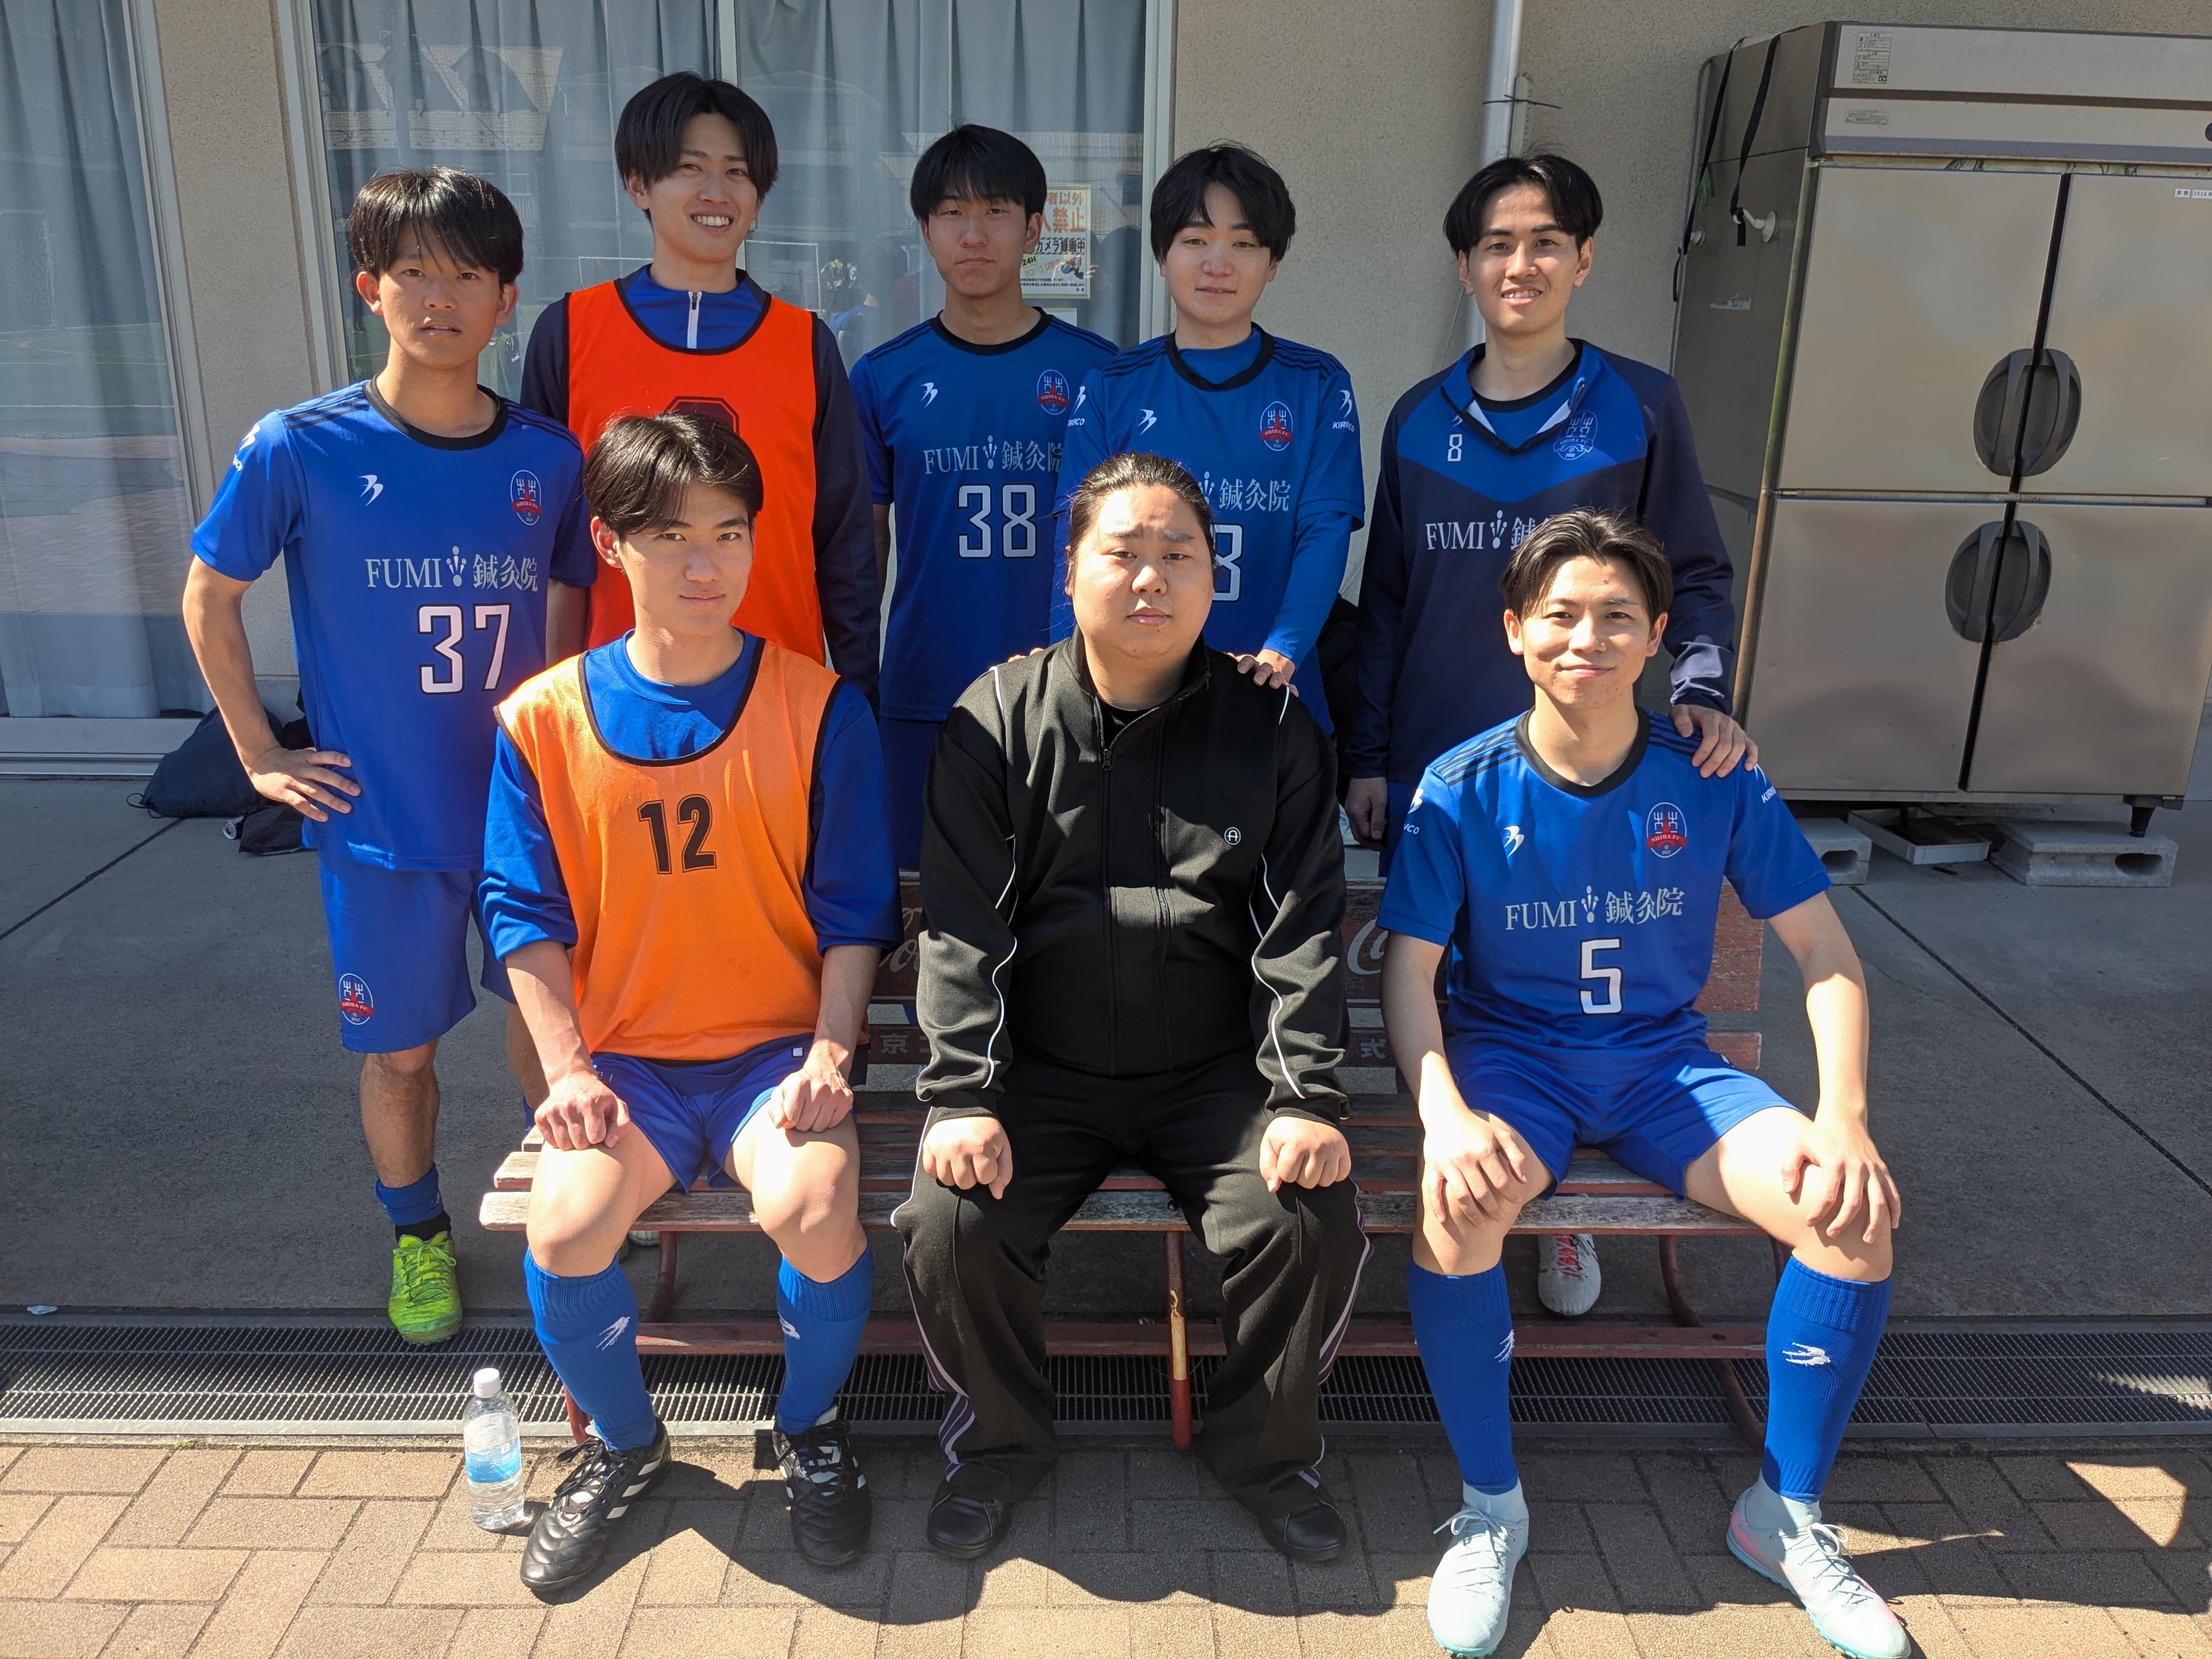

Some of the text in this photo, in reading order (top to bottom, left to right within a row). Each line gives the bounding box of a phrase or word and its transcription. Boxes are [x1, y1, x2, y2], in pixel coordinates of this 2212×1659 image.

[1023, 256, 1036, 266] 24H
[1033, 240, 1085, 252] カメラ録画中
[923, 440, 1064, 475] FUMI 鍼灸院
[1448, 434, 1463, 461] 8
[1218, 478, 1291, 512] 鍼灸院
[958, 484, 1036, 558] 38
[1425, 522, 1486, 550] FUMI
[364, 554, 538, 592] FUMI 鍼灸院
[417, 603, 512, 694] 37
[637, 793, 717, 874] 12
[1505, 887, 1685, 930] FUMI 鍼灸院
[1580, 937, 1622, 1014] 5
